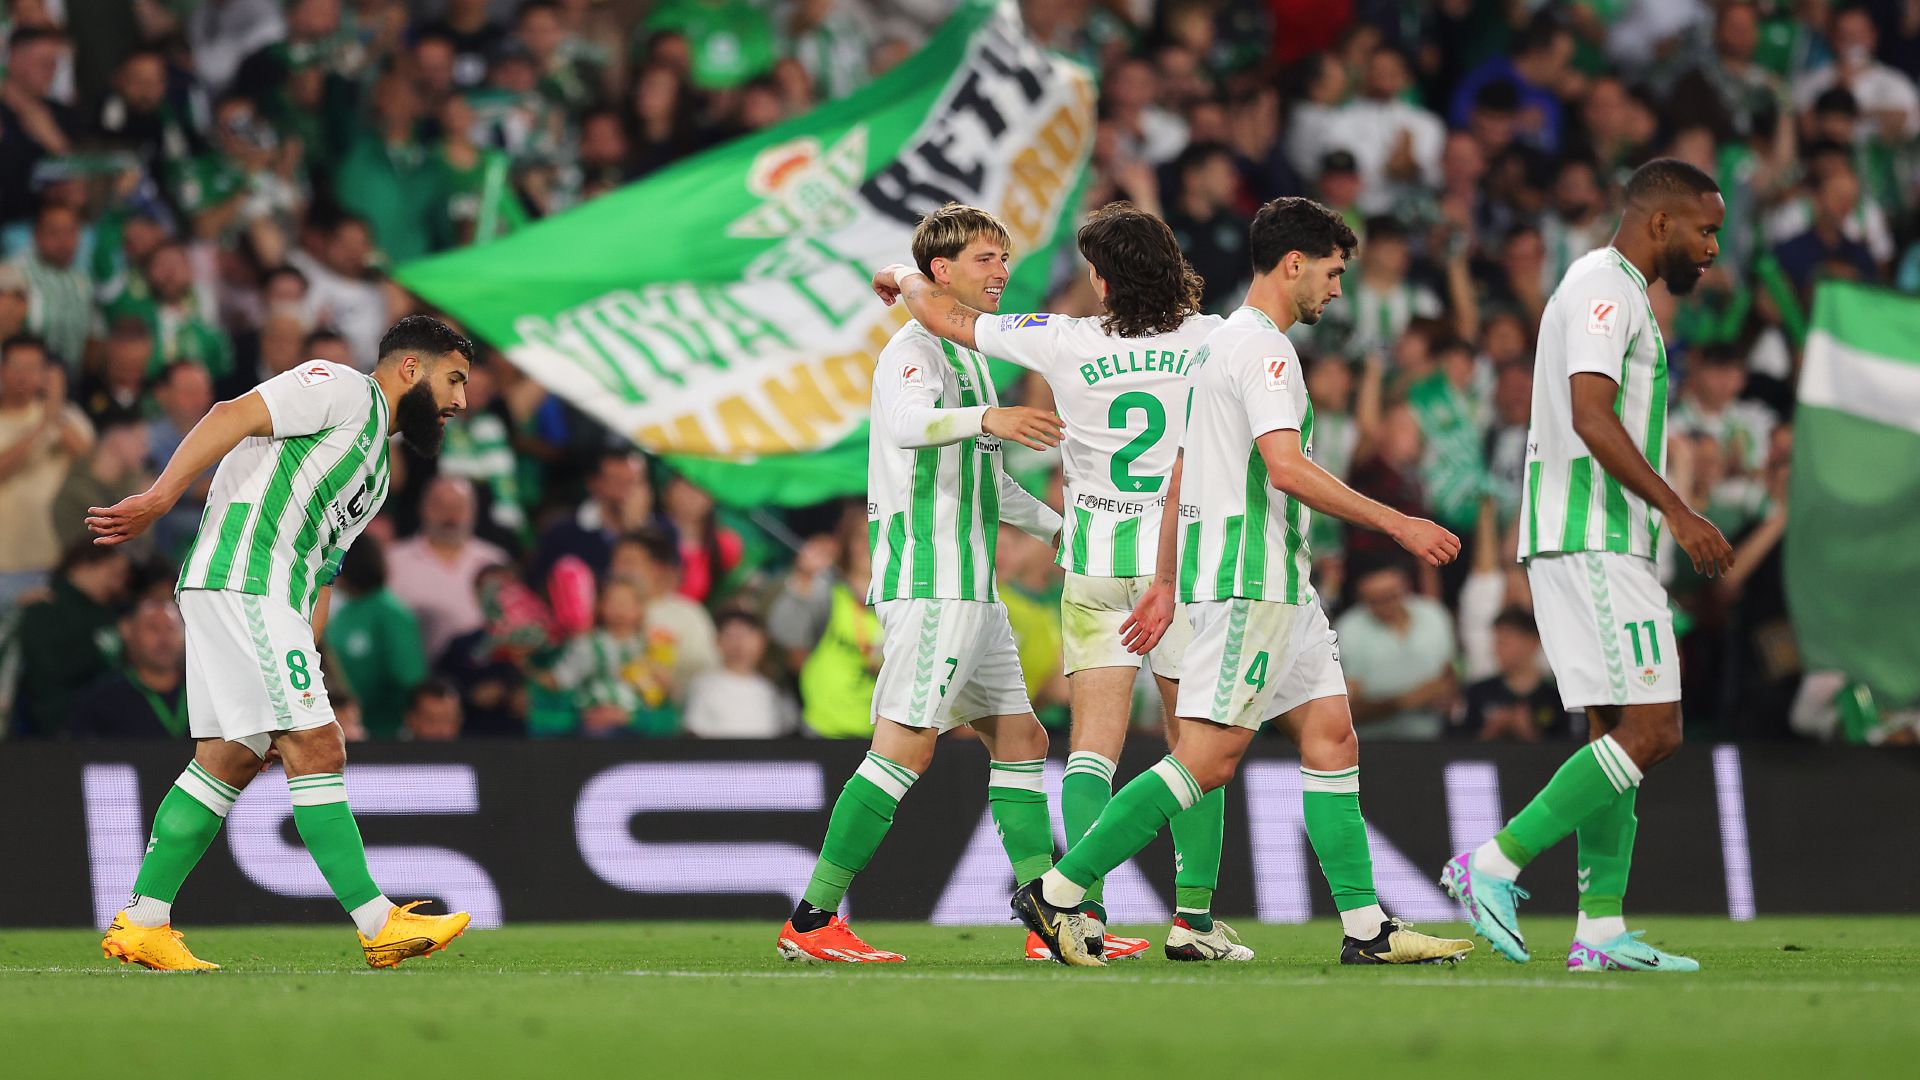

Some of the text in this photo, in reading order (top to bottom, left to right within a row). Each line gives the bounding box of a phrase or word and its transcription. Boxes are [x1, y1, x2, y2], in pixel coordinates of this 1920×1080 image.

[1079, 349, 1190, 386] BELLERÍ
[1108, 391, 1167, 492] 2
[1624, 620, 1662, 667] 11
[286, 649, 311, 690] 8
[1244, 651, 1269, 693] 4
